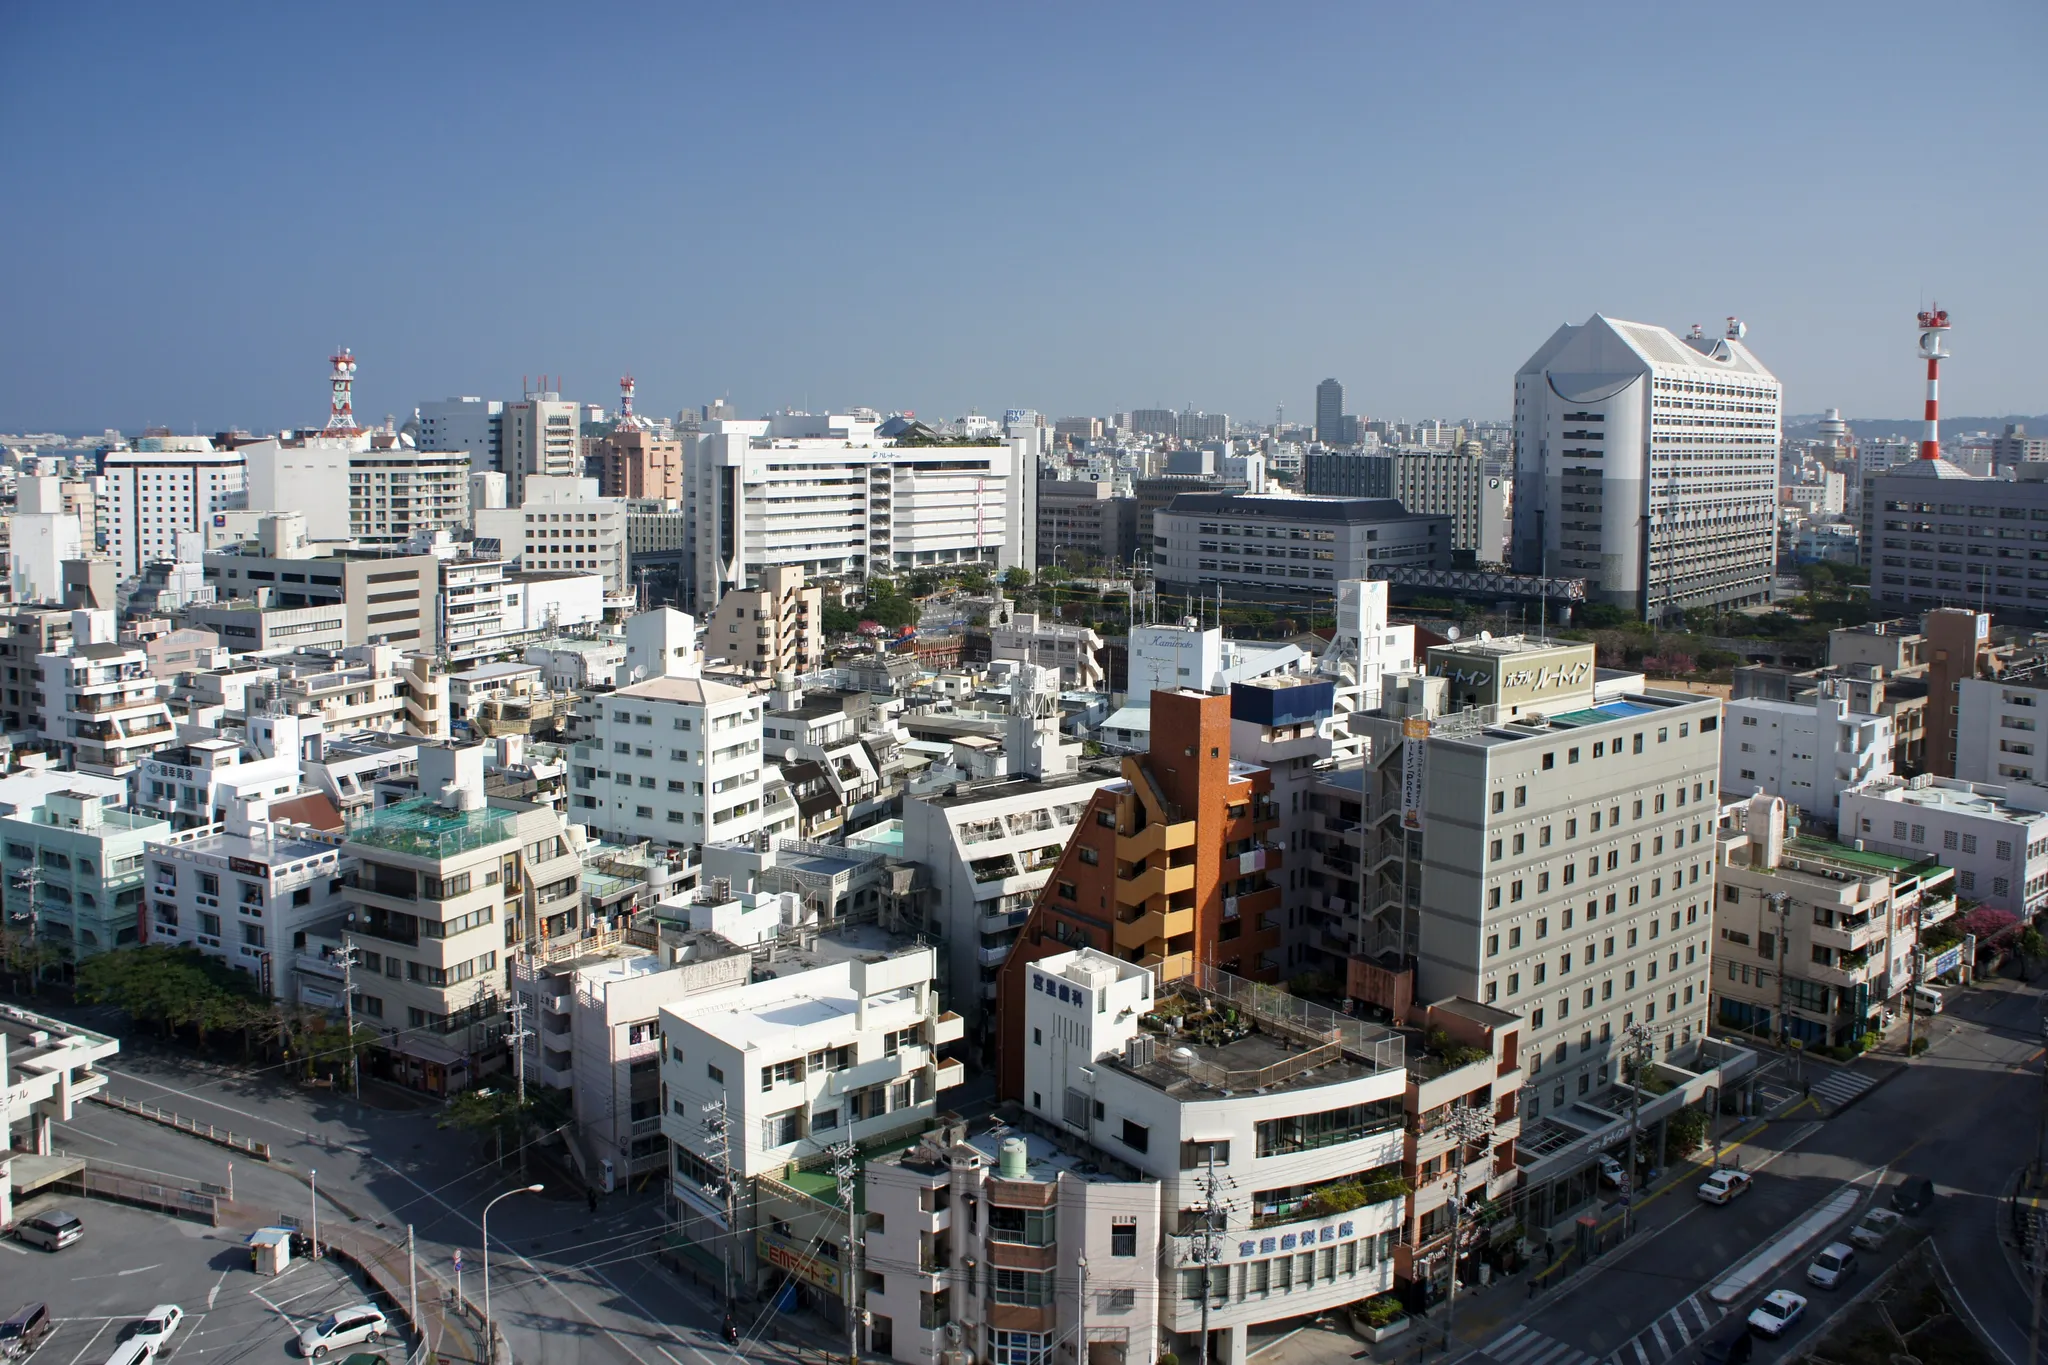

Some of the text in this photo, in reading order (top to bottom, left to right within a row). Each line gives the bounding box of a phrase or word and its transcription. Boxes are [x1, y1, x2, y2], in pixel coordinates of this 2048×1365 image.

[41, 527, 48, 536] P
[1433, 663, 1491, 687] ルートイン
[1504, 661, 1590, 691] ホテル ルートイン
[1033, 973, 1083, 1008] 宮里歯科
[1239, 1220, 1354, 1257] 宮里歯科医院
[769, 1245, 820, 1280] EMマート
